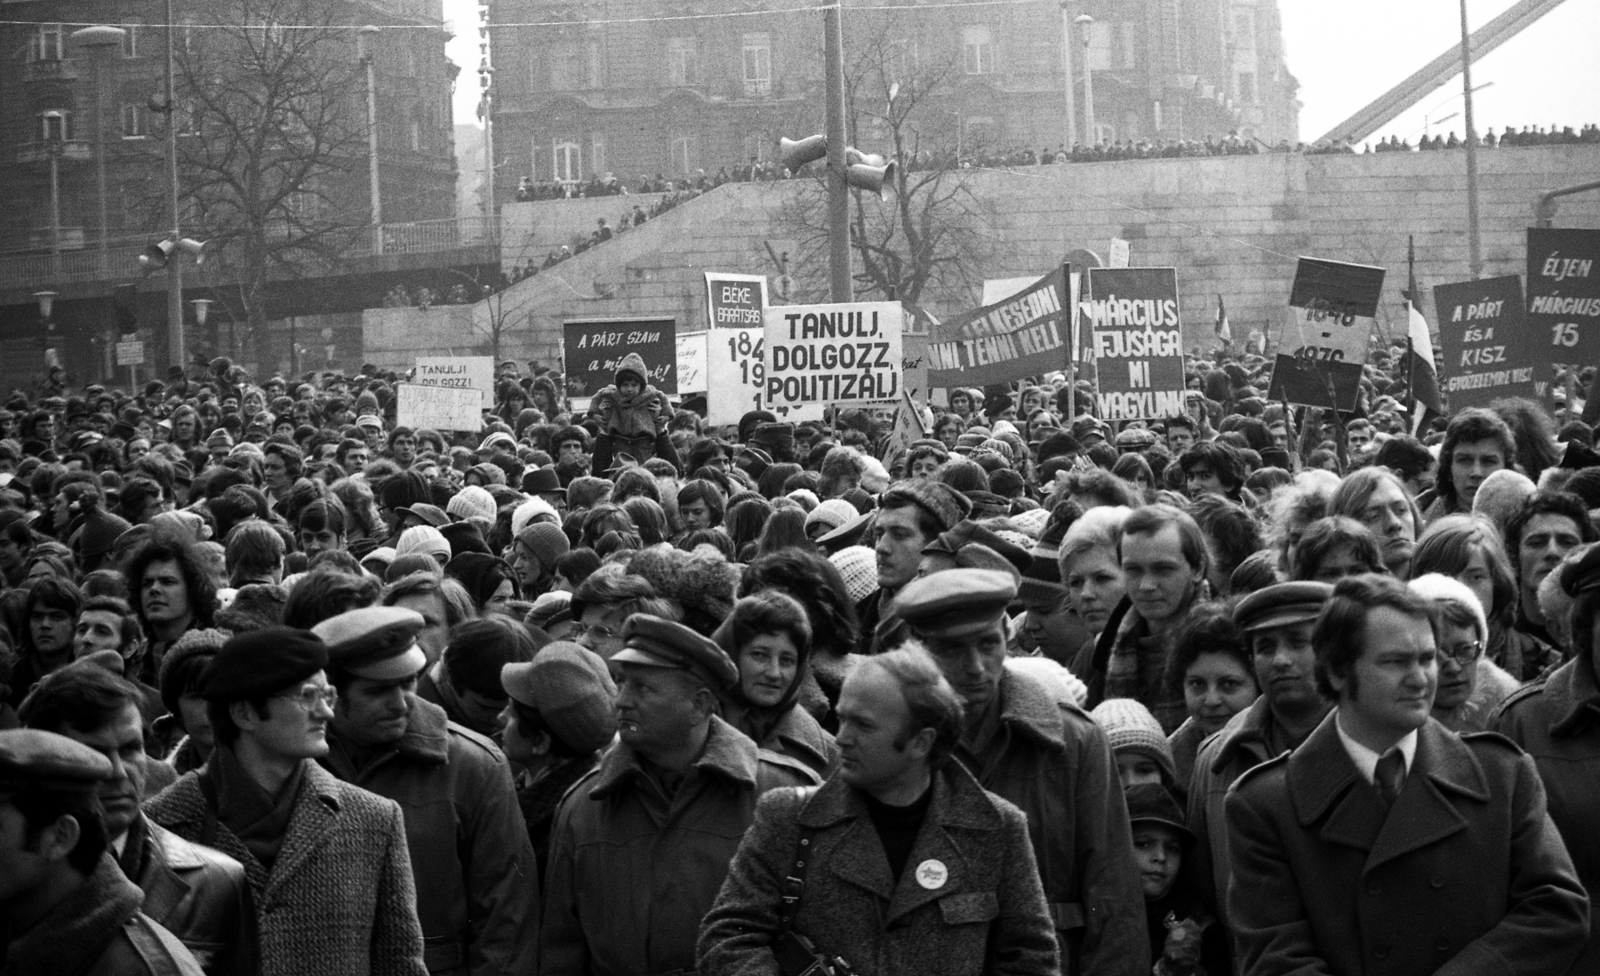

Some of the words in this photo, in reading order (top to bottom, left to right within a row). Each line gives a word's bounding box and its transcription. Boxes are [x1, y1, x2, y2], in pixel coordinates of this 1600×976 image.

[1542, 251, 1593, 282] ÉLJEN
[722, 282, 751, 304] BÉKE
[717, 305, 760, 323] BARÁTSÁG
[1092, 294, 1178, 327] MÁRCIUS
[1452, 305, 1463, 322] A
[1467, 297, 1504, 321] PÁRT
[785, 311, 884, 340] TANULJ,
[1463, 325, 1482, 343] ÉS
[1484, 327, 1495, 340] A
[1551, 322, 1580, 348] 15
[577, 334, 588, 349] A
[591, 331, 624, 348] PÁRT
[627, 331, 661, 345] SZAVA
[962, 334, 1019, 368] TENNI
[773, 343, 894, 372] DOLGOZZ,
[1460, 345, 1507, 367] KISZ
[420, 364, 467, 375] TANULJ!
[1128, 361, 1151, 388] MI
[767, 368, 898, 403] POLITIZÁLJ
[1097, 391, 1186, 420] VAGYUNK
